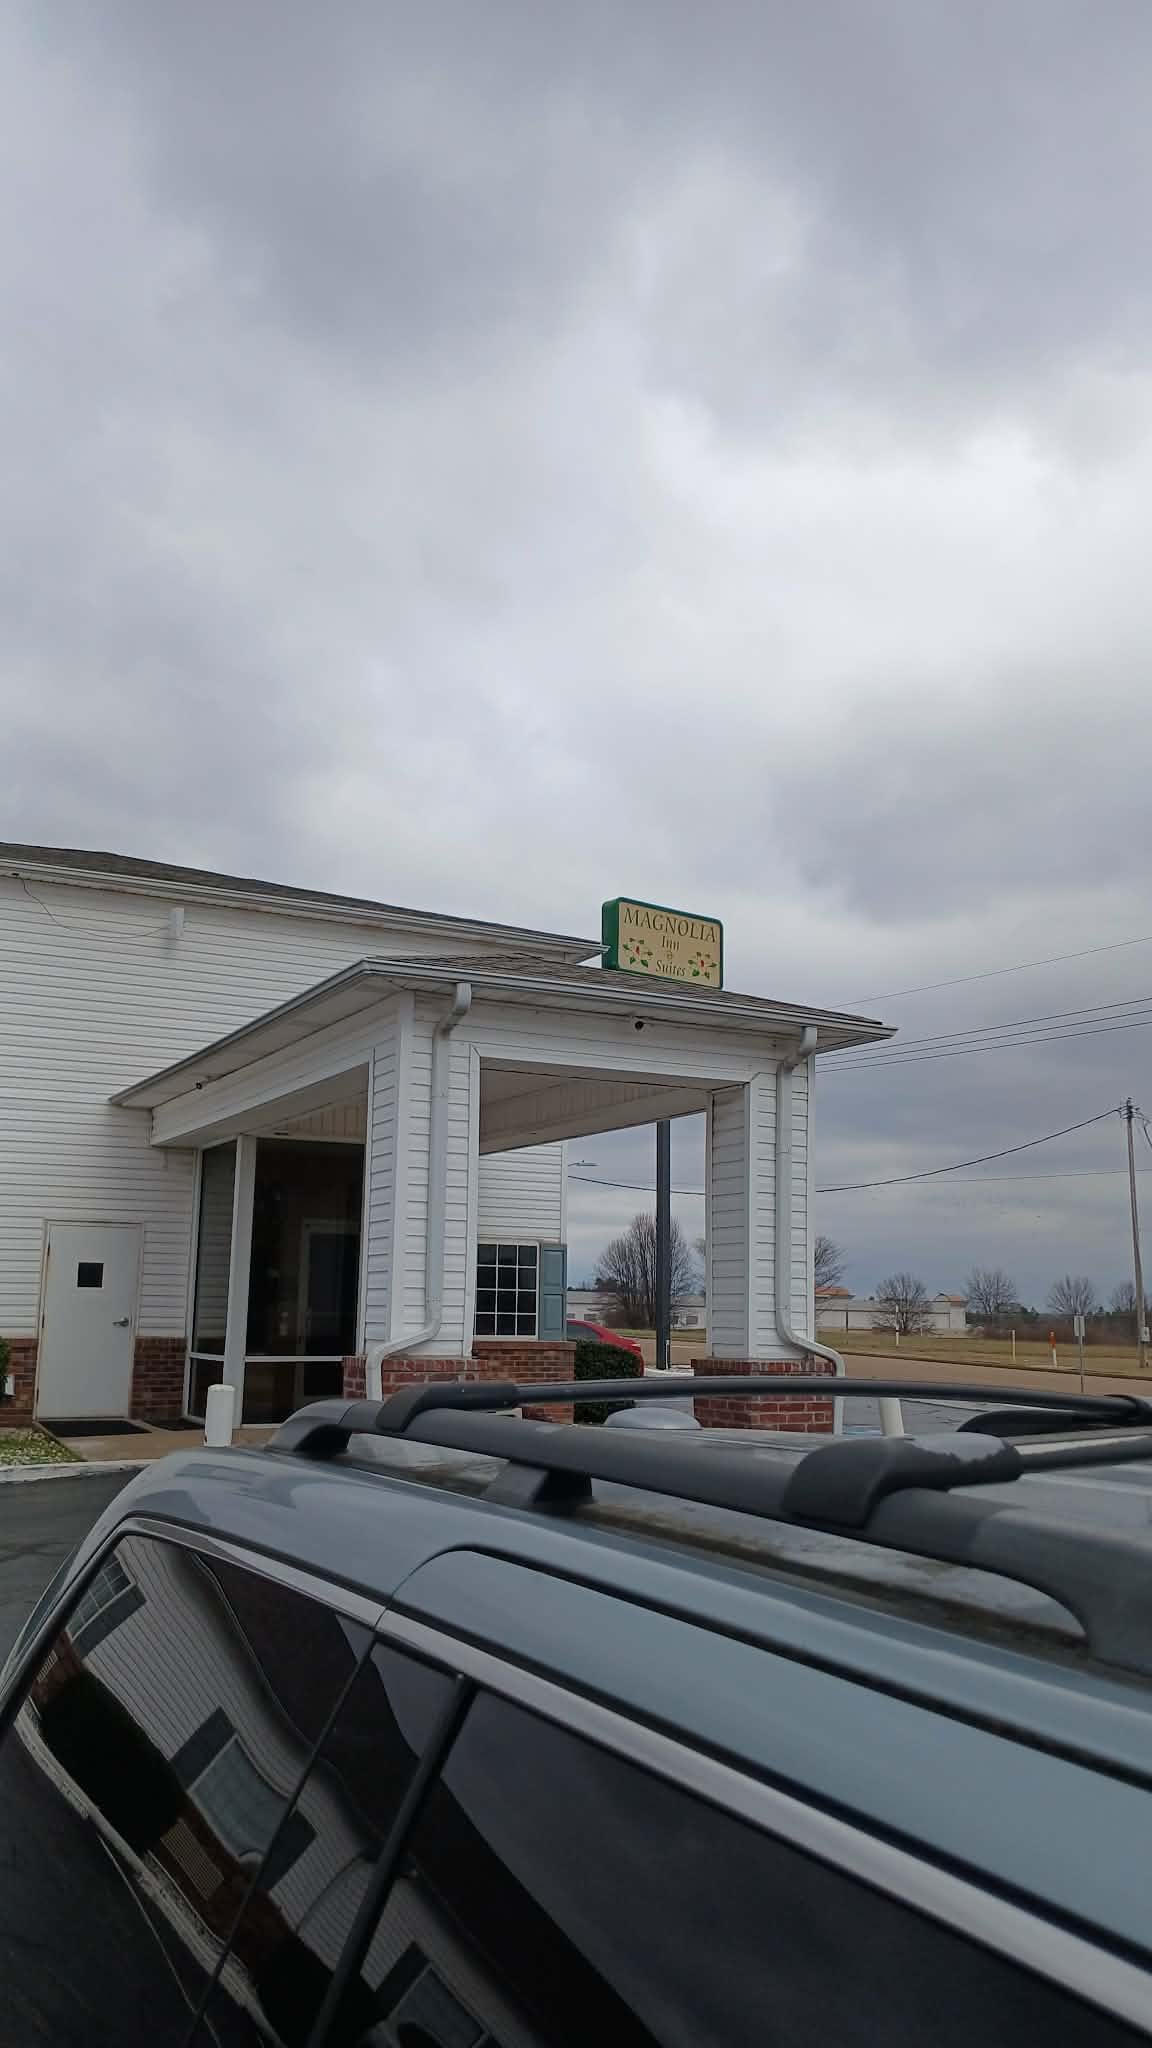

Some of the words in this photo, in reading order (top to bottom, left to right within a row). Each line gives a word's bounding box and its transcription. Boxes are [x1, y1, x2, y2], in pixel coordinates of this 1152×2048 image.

[624, 908, 716, 943] MAGNOLIA
[661, 935, 680, 951] Inn
[655, 959, 686, 977] Suites
